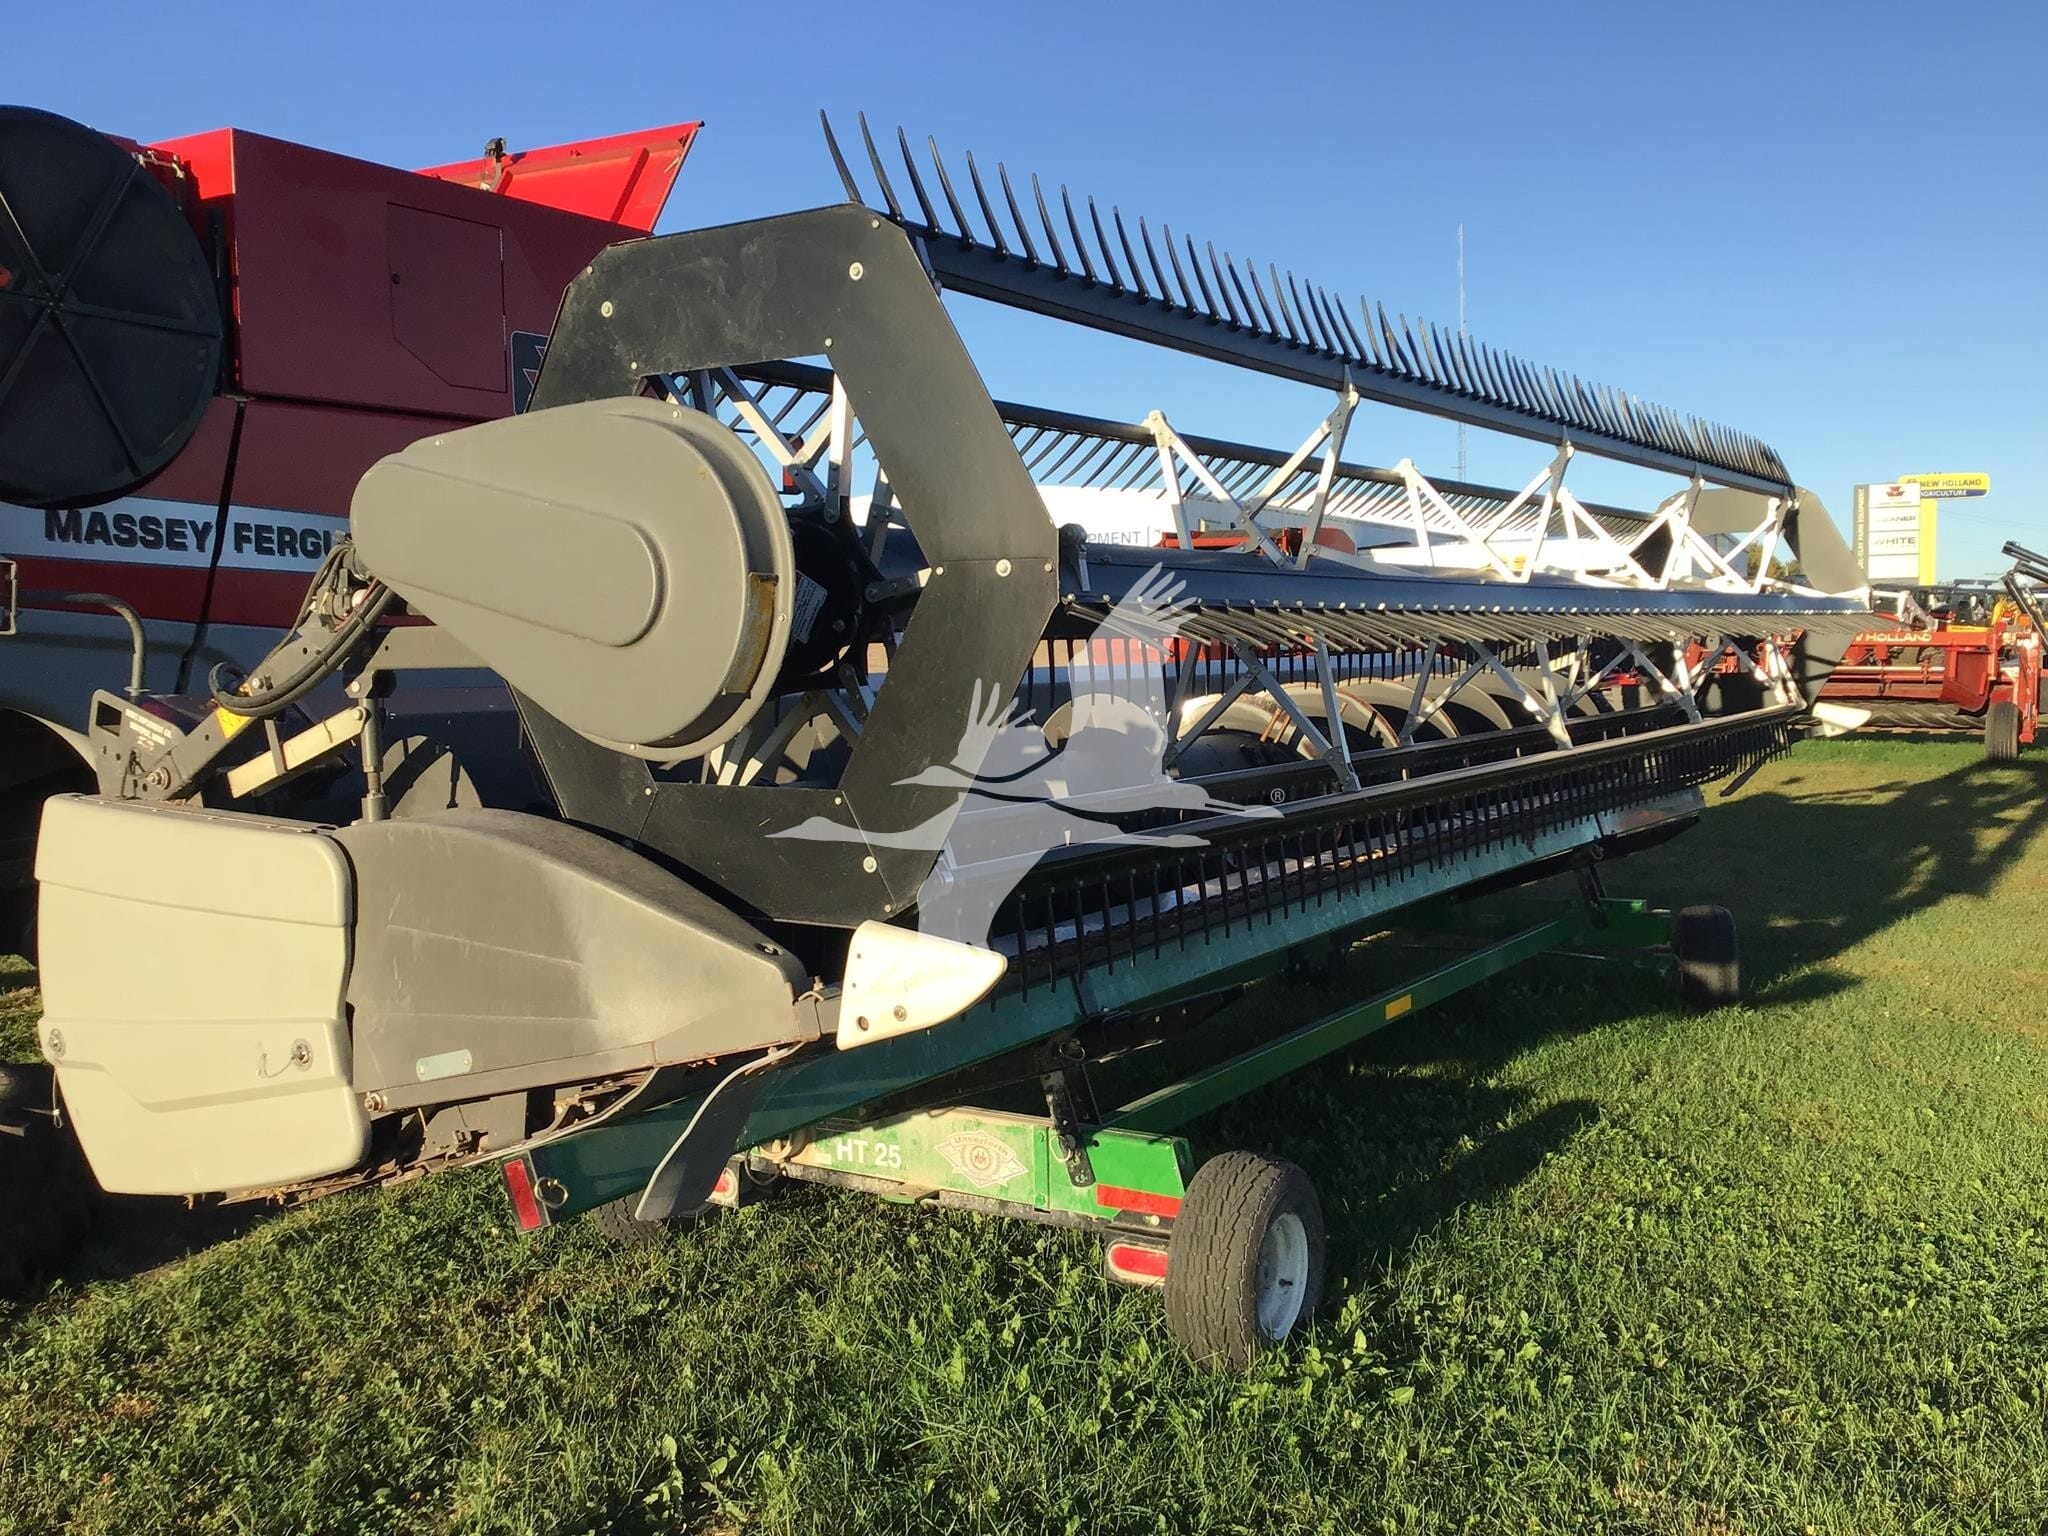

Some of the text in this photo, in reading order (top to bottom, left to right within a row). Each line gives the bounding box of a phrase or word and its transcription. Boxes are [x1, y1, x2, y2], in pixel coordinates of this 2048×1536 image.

[1942, 478, 1982, 488] HOLLAND
[44, 509, 214, 553] MASSEY
[1875, 537, 1916, 545] WHITE
[836, 1138, 902, 1169] HT 25
